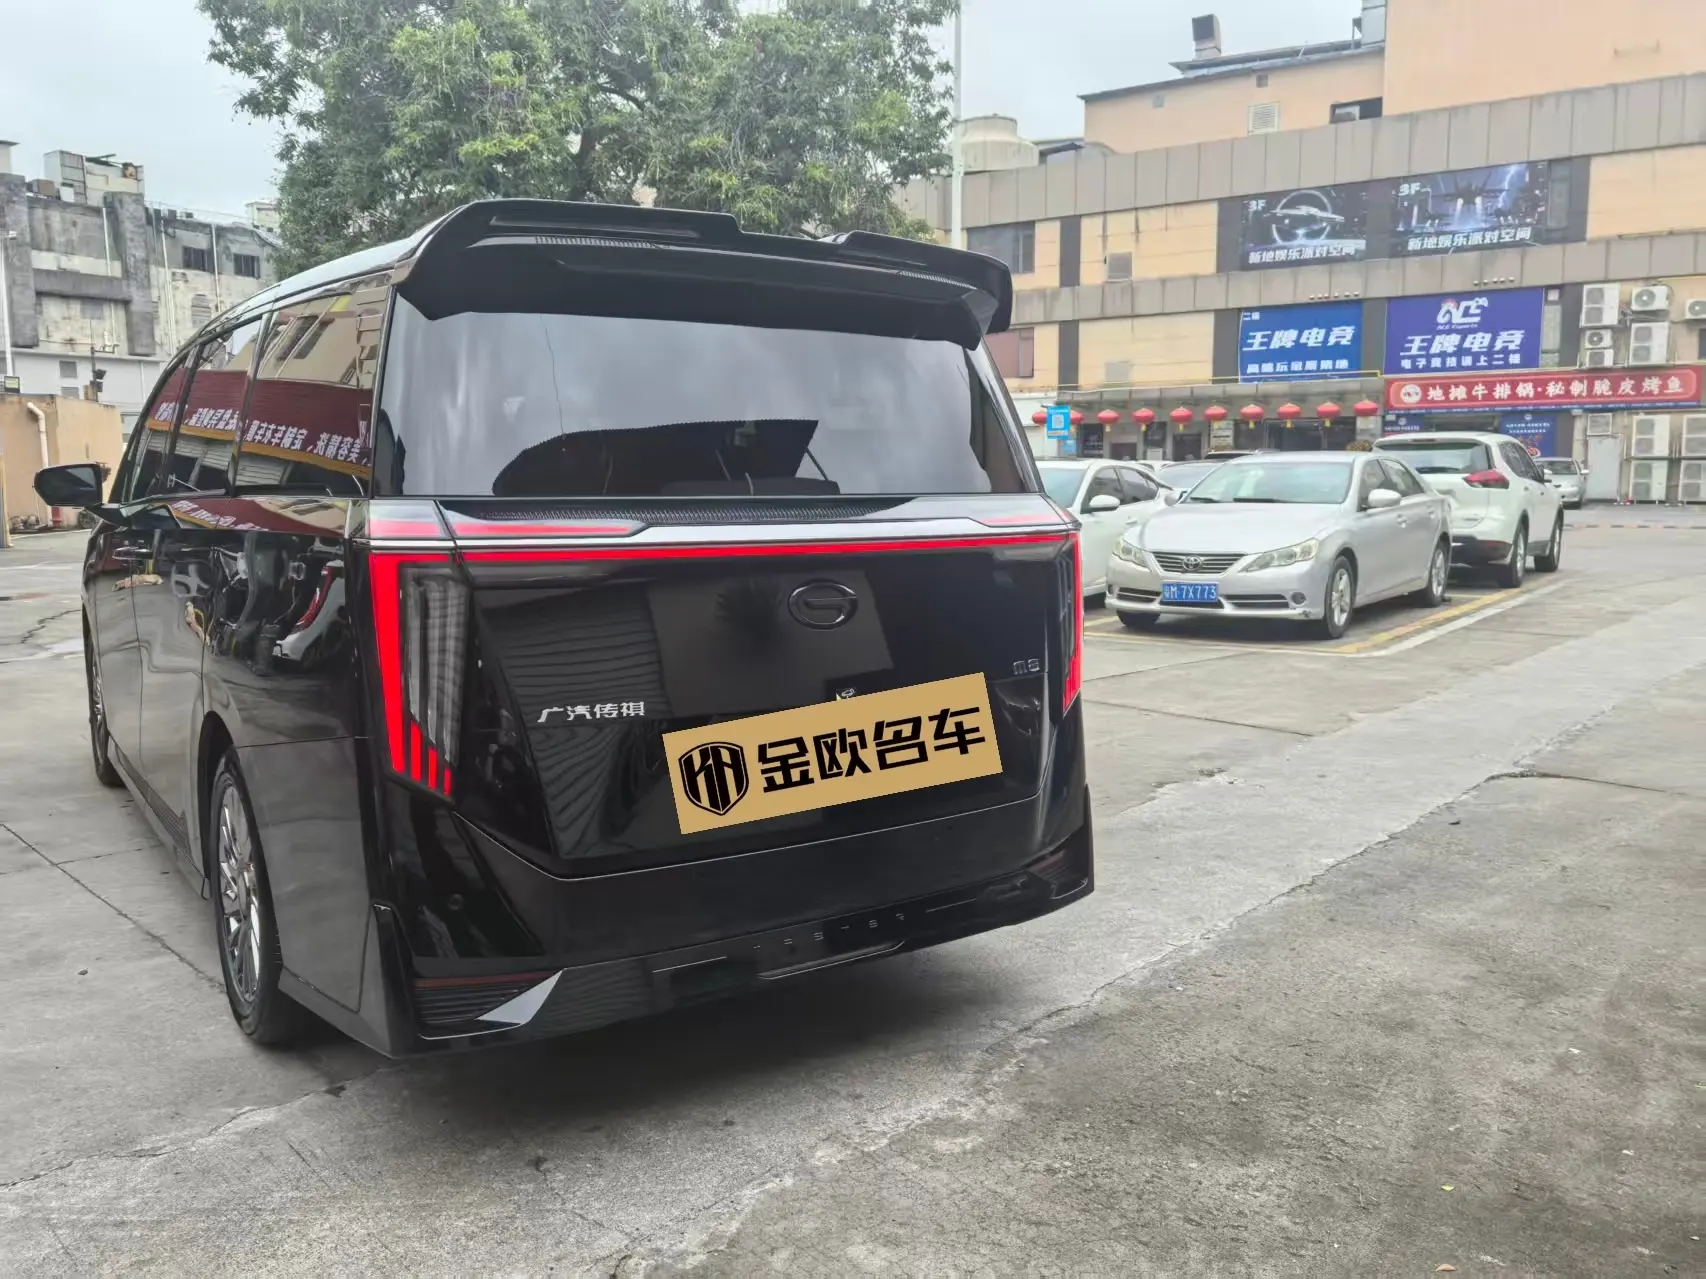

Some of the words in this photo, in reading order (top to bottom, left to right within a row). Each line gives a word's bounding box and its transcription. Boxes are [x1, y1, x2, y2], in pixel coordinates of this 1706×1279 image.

[1399, 183, 1421, 196] 3F
[1248, 200, 1266, 211] 3F
[1407, 226, 1532, 251] 新地娱乐派对空间
[1248, 244, 1356, 264] 新地娱乐派对空间
[1242, 325, 1356, 351] 王牌电竞
[1400, 329, 1525, 356] 王牌电竞
[1401, 353, 1521, 370] 电子竞技请上二楼
[537, 701, 645, 722] 广汽传祺
